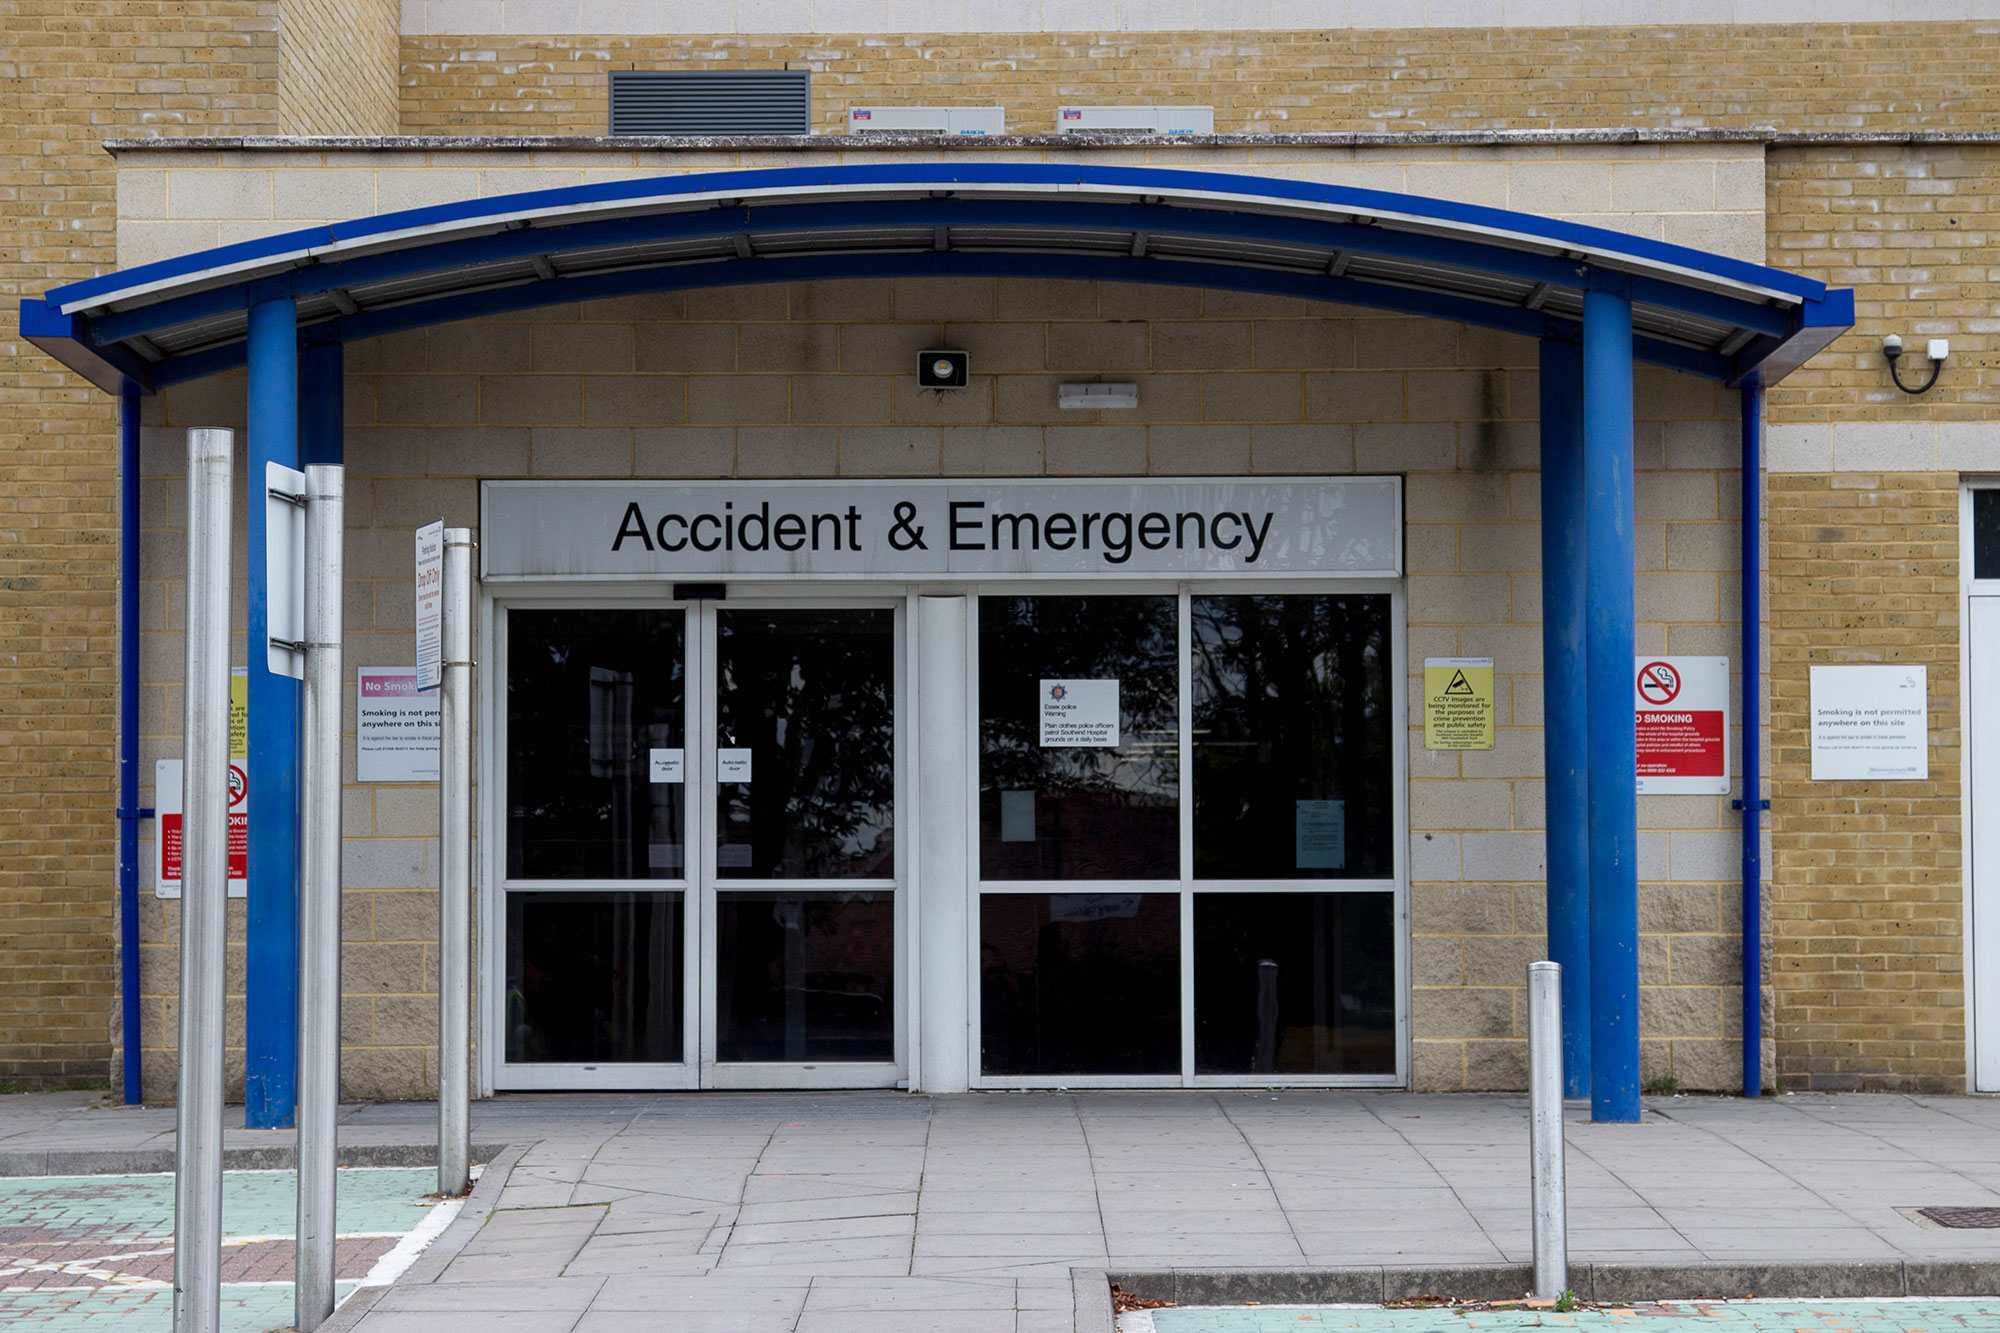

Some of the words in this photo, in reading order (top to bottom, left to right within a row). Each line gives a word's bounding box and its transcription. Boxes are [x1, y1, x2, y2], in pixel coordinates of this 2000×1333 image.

[612, 502, 862, 552] Accident
[887, 502, 928, 552] &
[948, 502, 1272, 563] Emergency
[365, 682, 380, 690] No
[384, 682, 417, 690] Smoki
[1881, 709, 1921, 718] permitted
[1636, 714, 1642, 723] O
[1644, 714, 1693, 723] SMOKING
